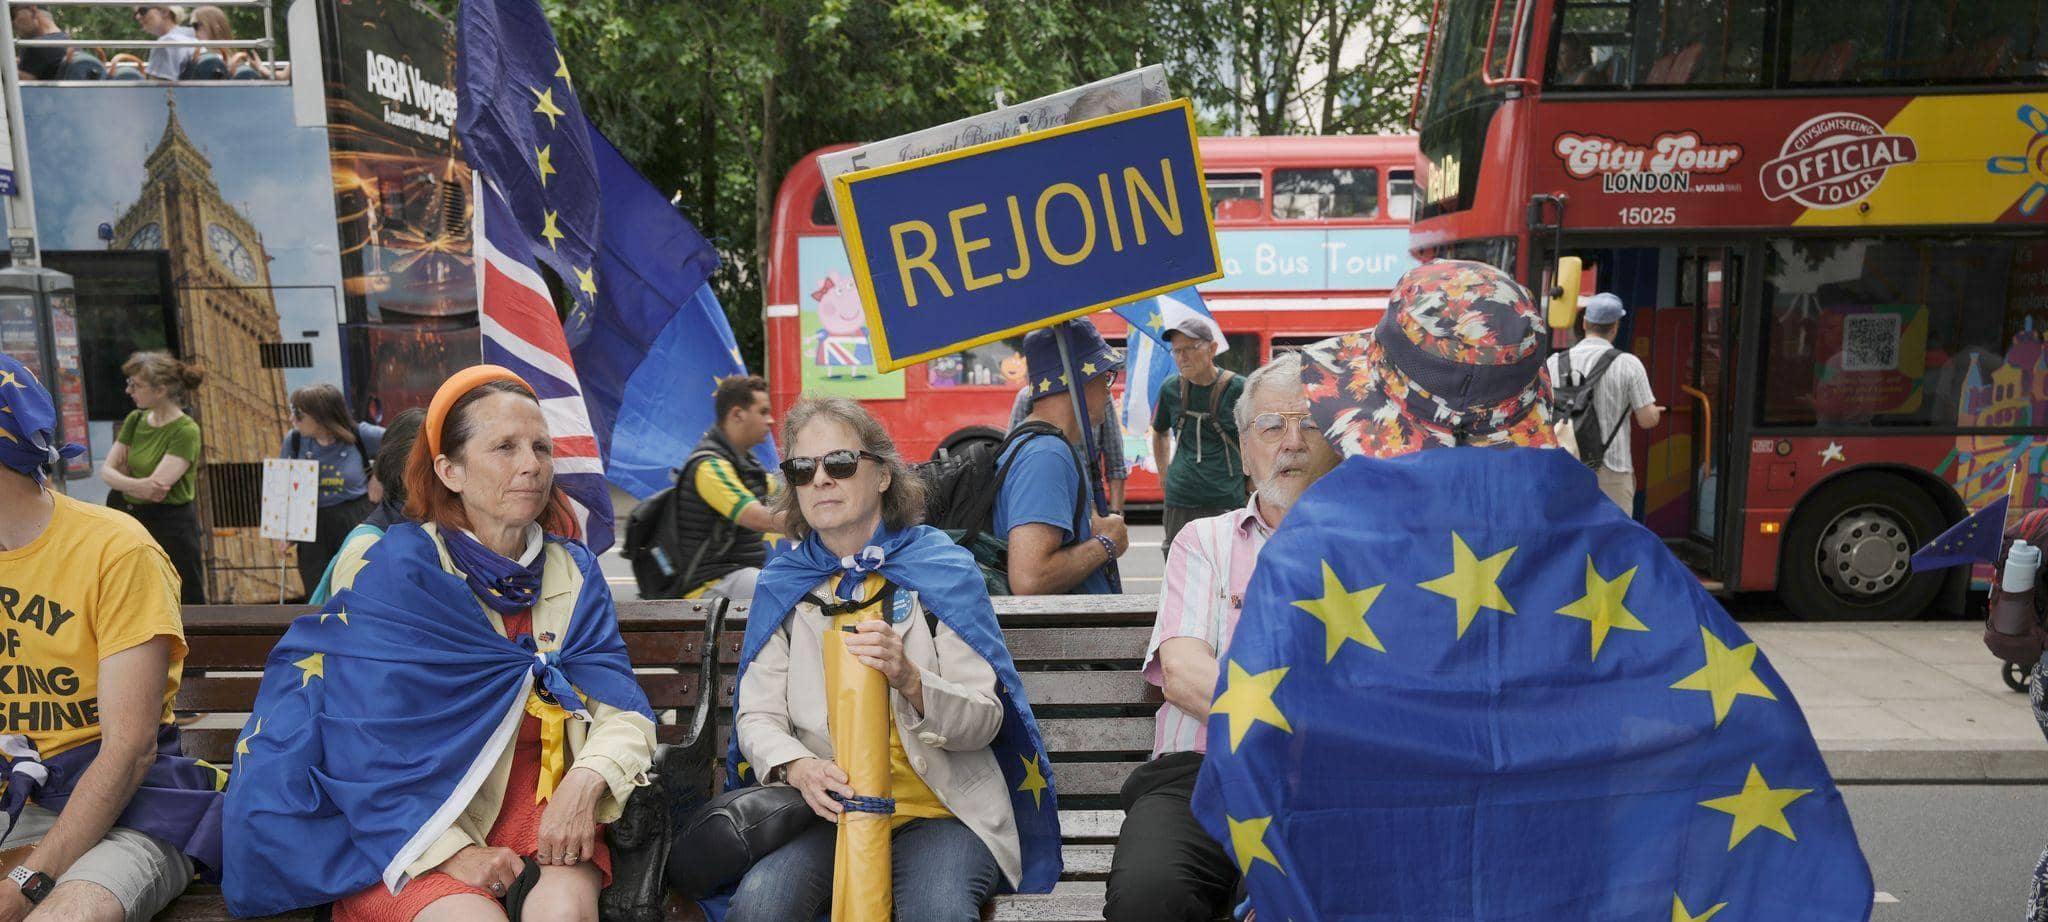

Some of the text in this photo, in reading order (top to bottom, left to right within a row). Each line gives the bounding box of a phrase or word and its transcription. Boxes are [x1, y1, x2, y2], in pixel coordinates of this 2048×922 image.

[366, 49, 412, 105] ABBA
[1794, 119, 1875, 150] CITYSIGHTSEEING
[1558, 135, 1738, 174] City Tour
[1776, 139, 1908, 190] OFFICIAL
[1603, 171, 1690, 193] LONDON
[1817, 174, 1876, 202] TOUR
[889, 158, 1183, 307] REJOIN
[1618, 207, 1676, 224] 15025
[1255, 241, 1310, 275] Bus
[1321, 242, 1398, 275] Tour
[0, 586, 75, 636] RAY
